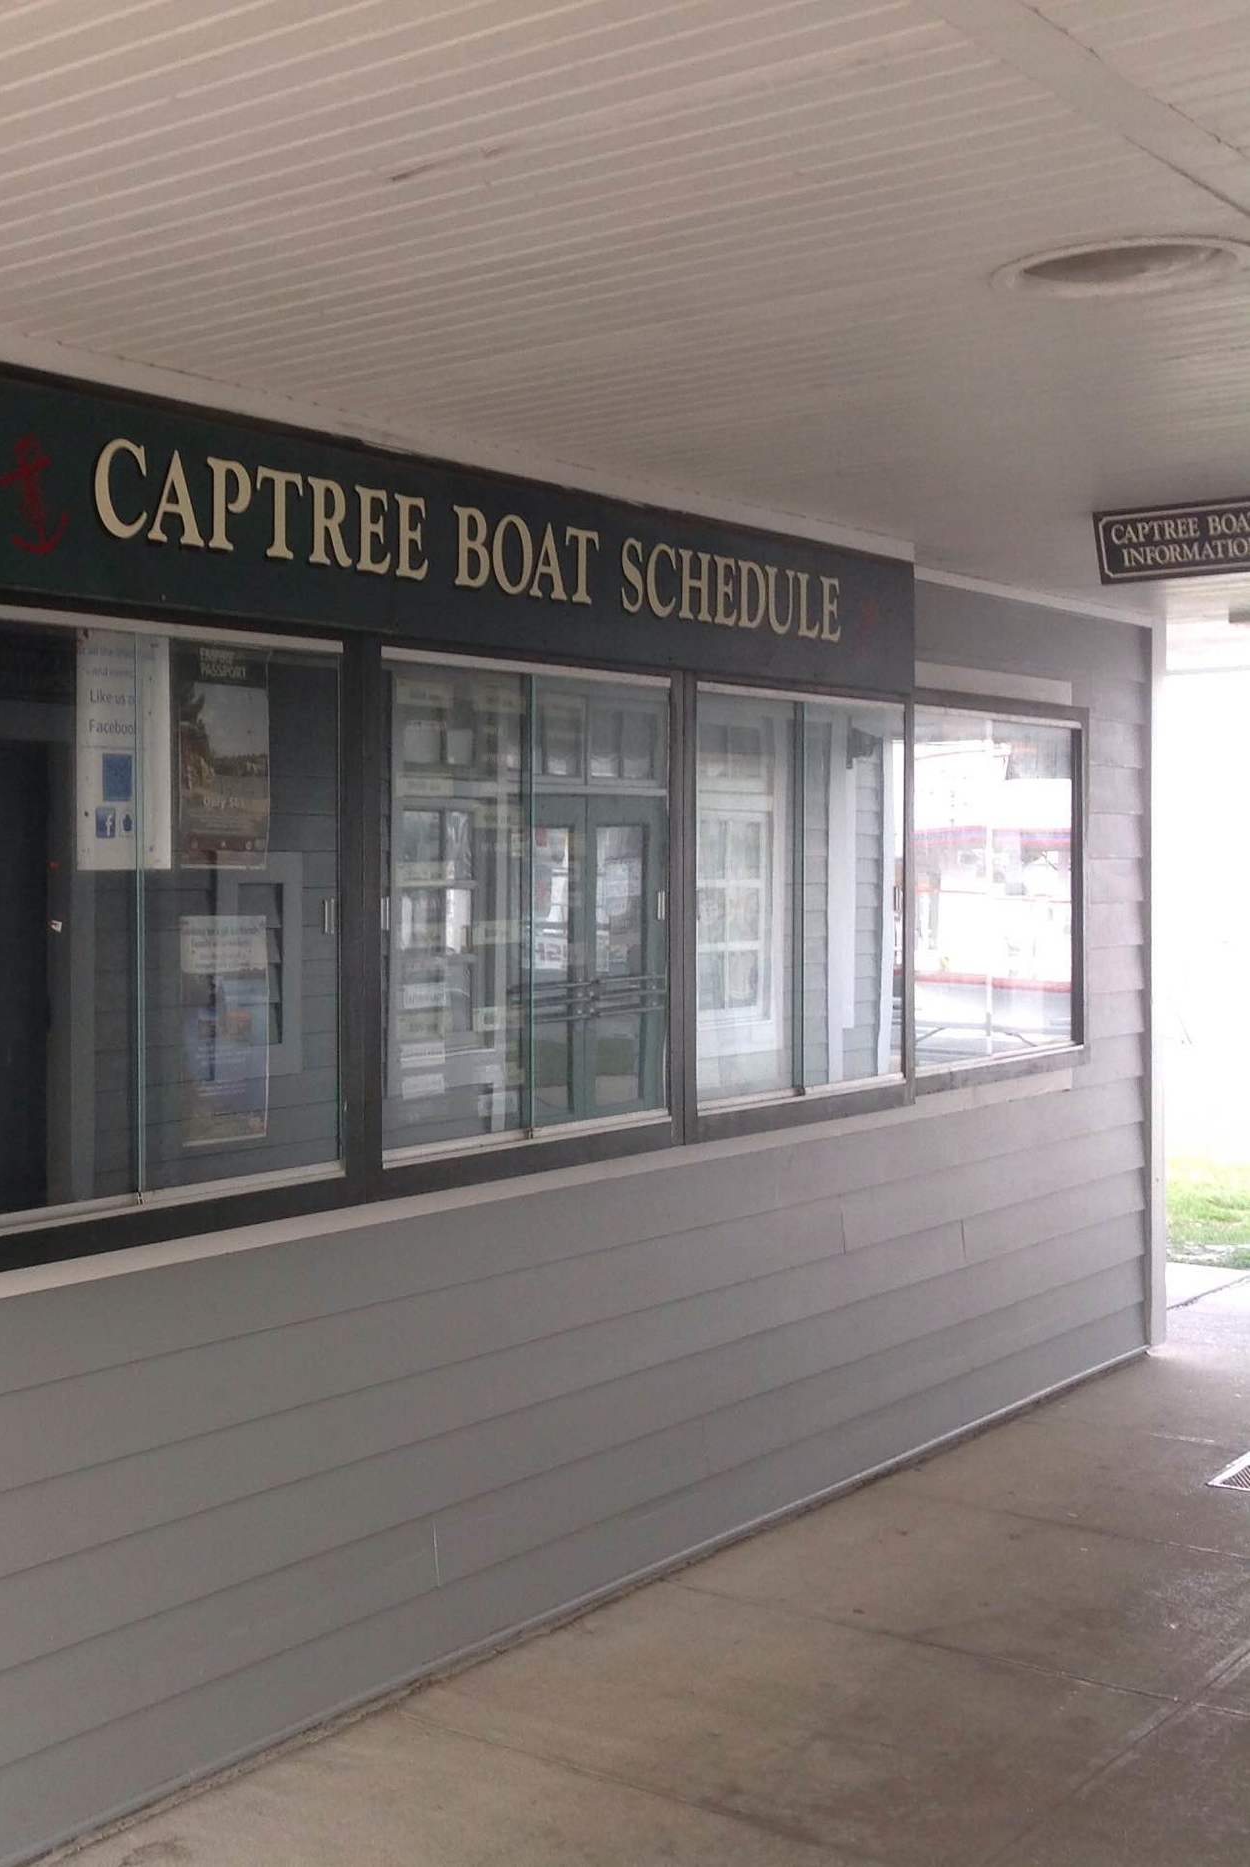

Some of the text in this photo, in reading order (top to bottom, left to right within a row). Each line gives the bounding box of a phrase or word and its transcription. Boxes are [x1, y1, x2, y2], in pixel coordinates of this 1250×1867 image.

[94, 437, 842, 643] CAPTREE BOAT SCHEDULE
[1111, 517, 1199, 544] CAPTREE
